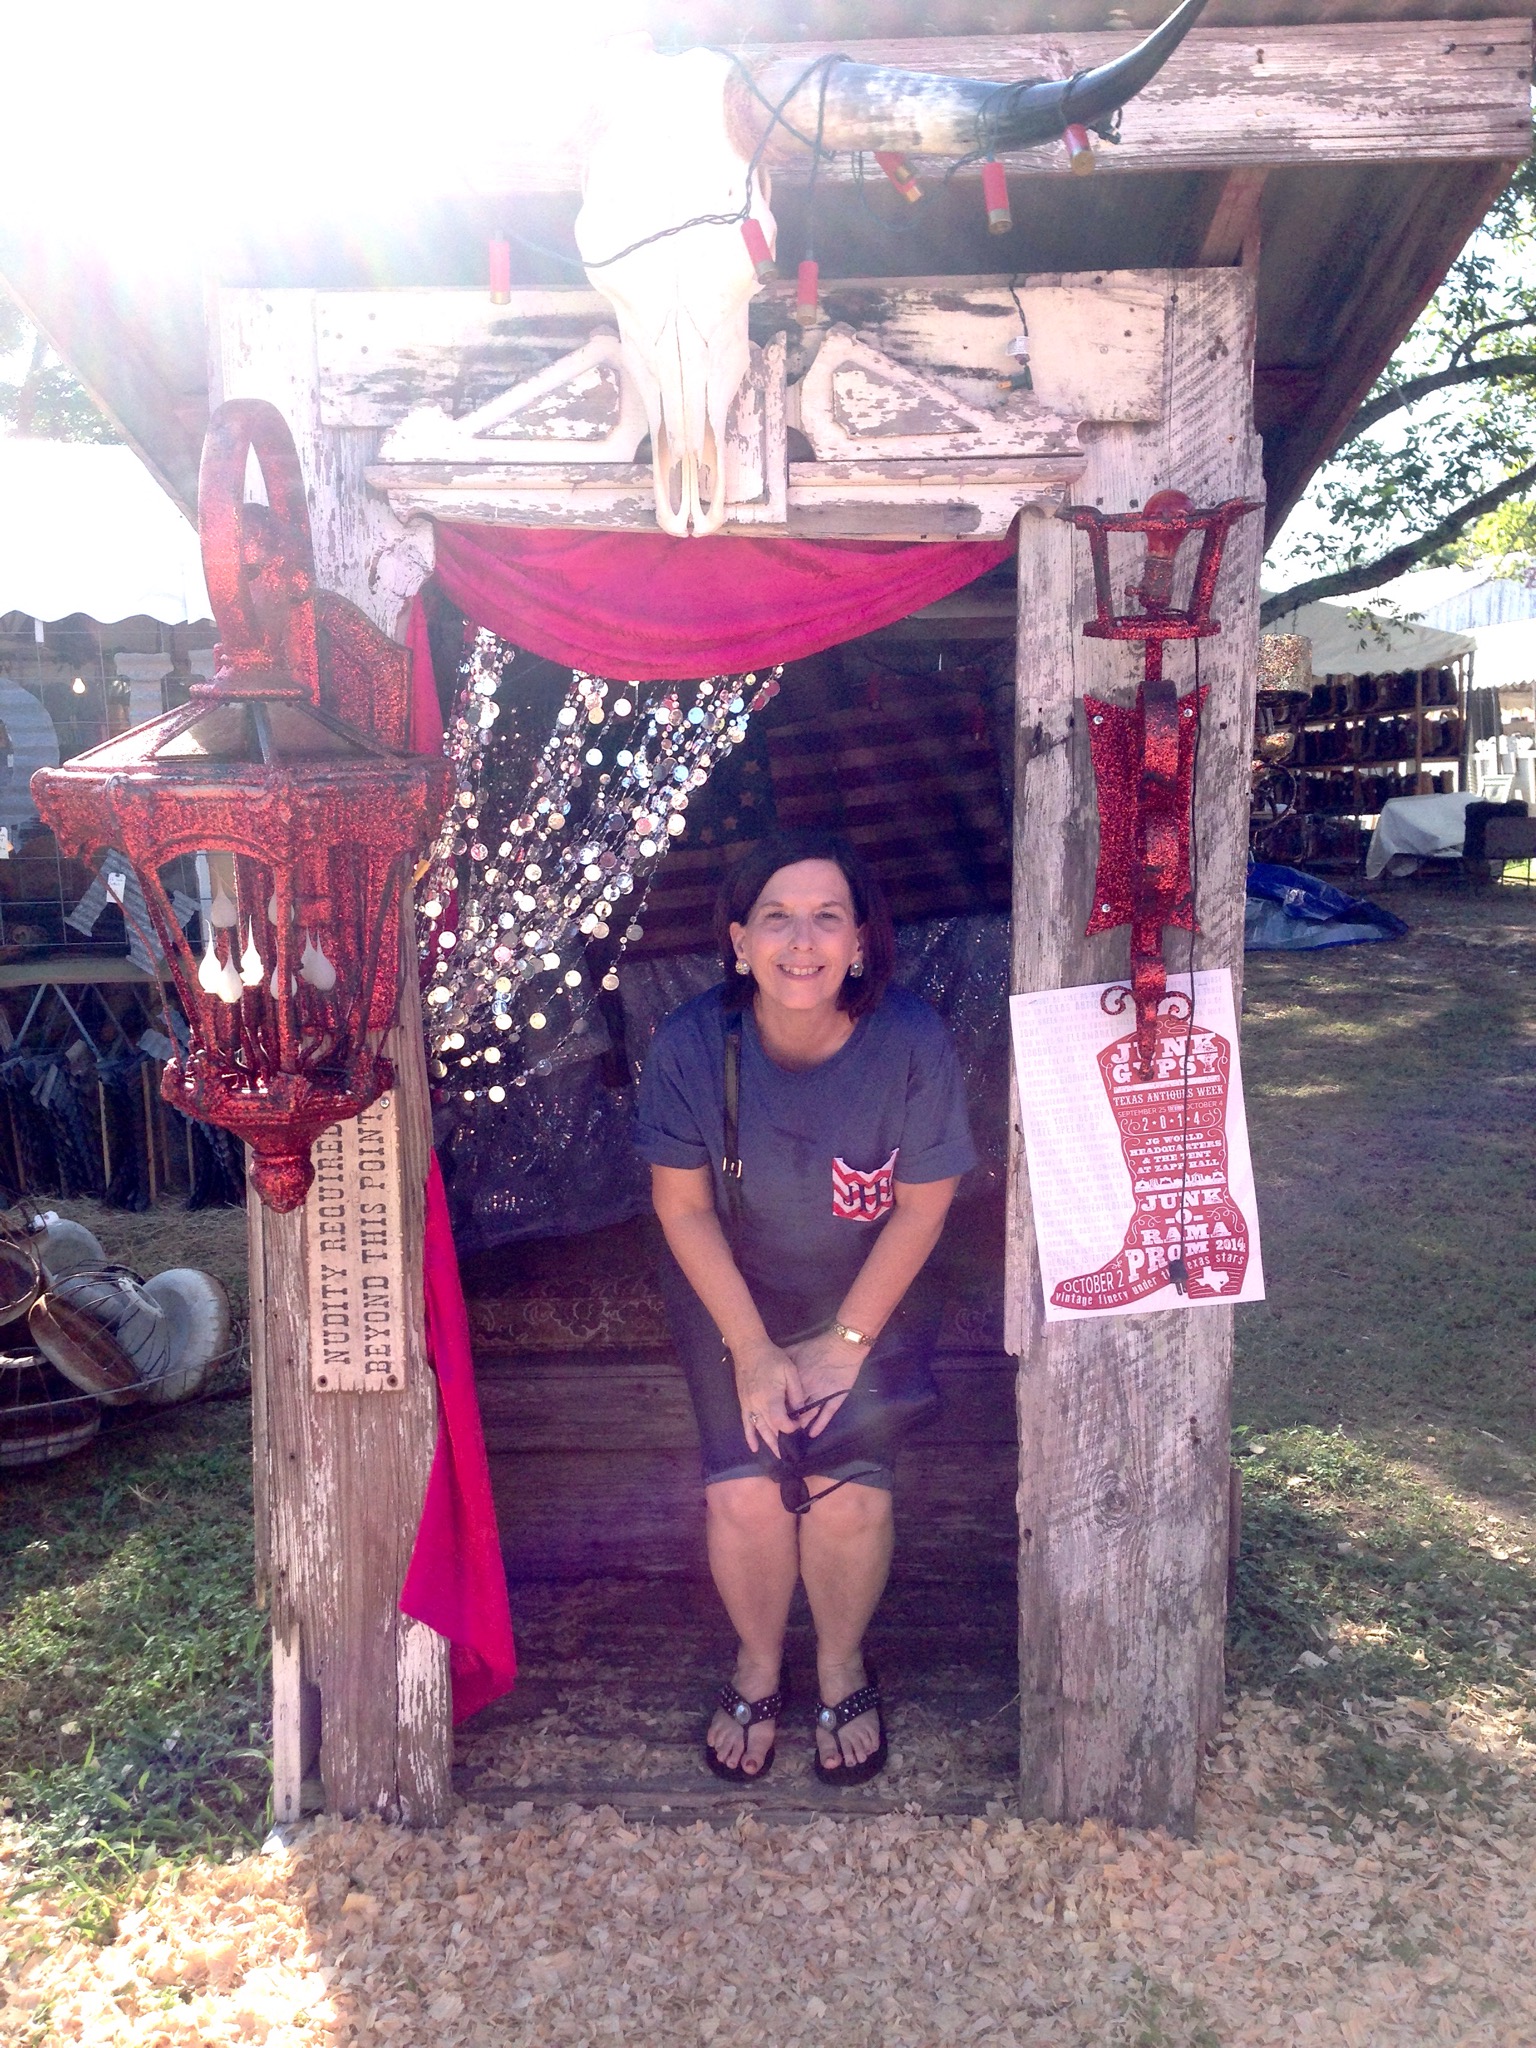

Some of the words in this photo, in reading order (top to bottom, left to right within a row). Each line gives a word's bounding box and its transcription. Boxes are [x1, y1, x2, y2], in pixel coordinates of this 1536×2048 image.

[1112, 1094, 1143, 1106] TEXAS
[1196, 1085, 1224, 1097] WEEK
[1118, 1107, 1157, 1117] SEPTEMBER
[357, 1107, 386, 1190] POINT
[1129, 1140, 1222, 1156] HEADQUARTERS
[1162, 1133, 1204, 1144] WORLD
[1137, 1166, 1151, 1174] AT
[1188, 1159, 1219, 1168] HALL
[1142, 1157, 1150, 1165] &
[1154, 1154, 1177, 1163] THE
[1180, 1150, 1212, 1160] TENT
[316, 1123, 346, 1252] REQUIRED
[1141, 1188, 1223, 1211] JUNK
[360, 1202, 388, 1264] THIS
[1140, 1221, 1231, 1245] RAMA
[1125, 1241, 1210, 1283] PROM
[1215, 1237, 1246, 1252] 2014
[1055, 1292, 1092, 1306] vintage
[1098, 1290, 1129, 1305] finery
[1132, 1278, 1158, 1294] under
[1187, 1253, 1210, 1270] exas
[1215, 1252, 1244, 1265] stars
[1063, 1272, 1114, 1294] OCTOBER
[1117, 1270, 1125, 1288] 2
[321, 1264, 350, 1364] NUDITY
[362, 1275, 391, 1375] BEYOND
